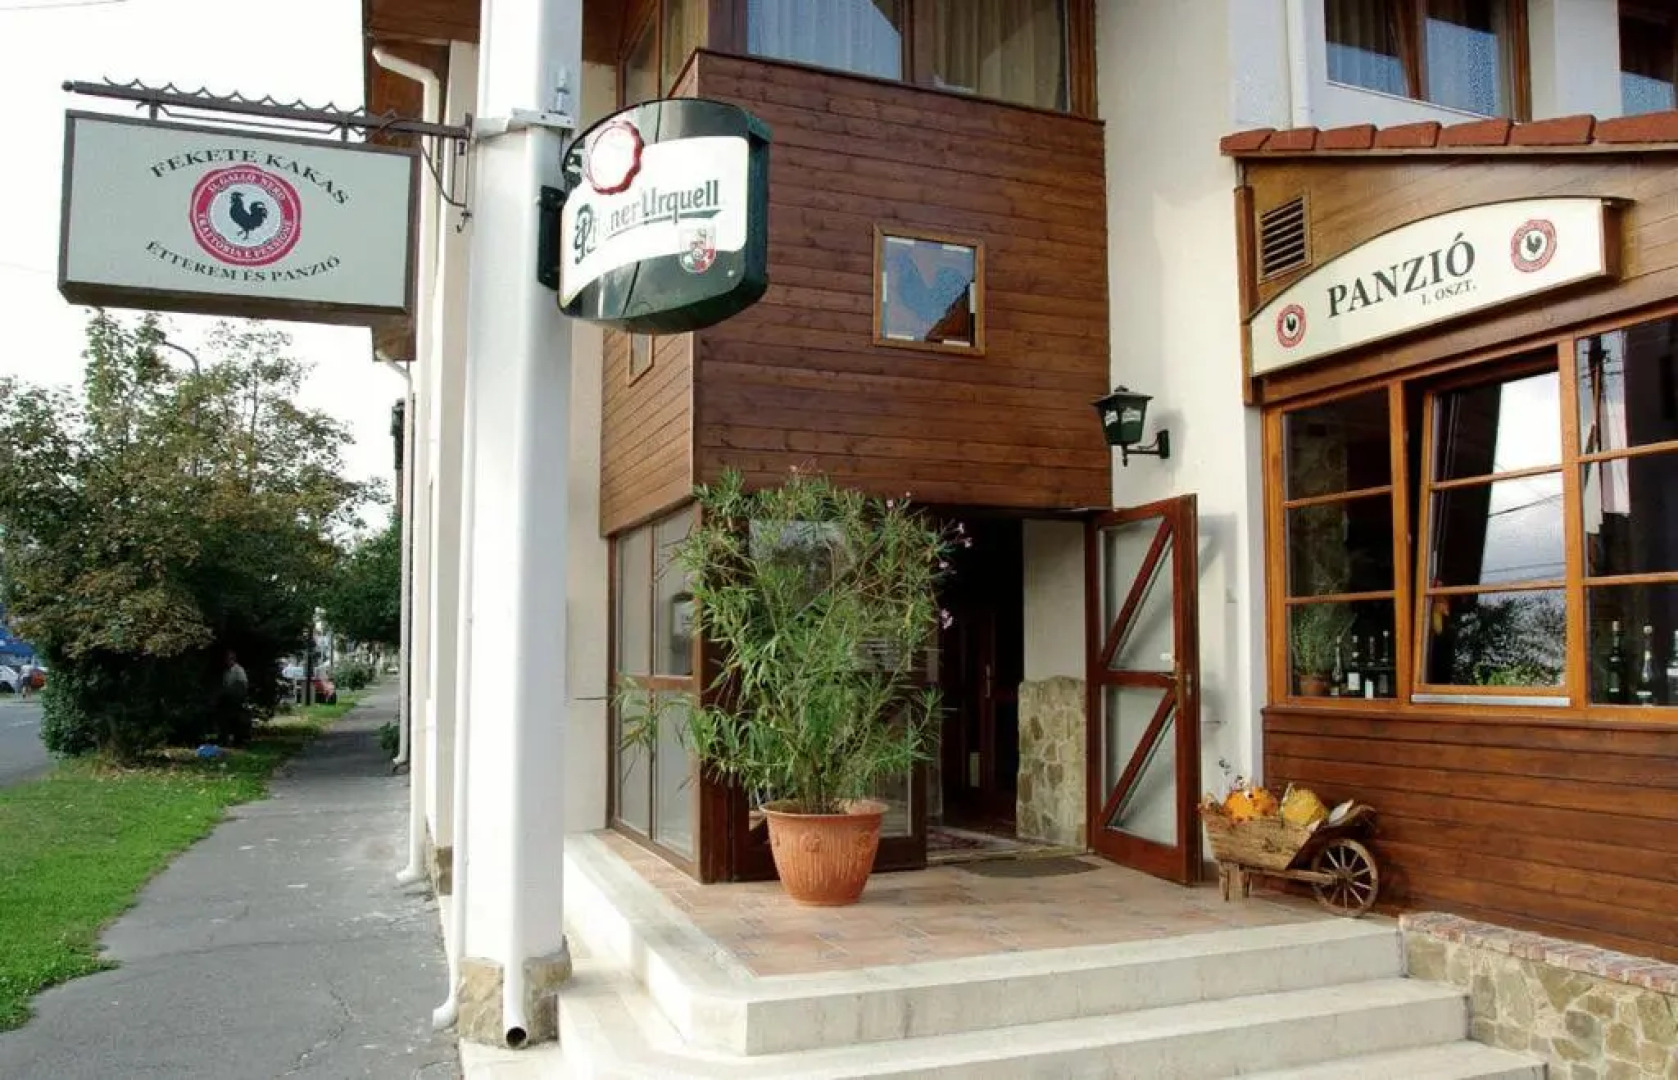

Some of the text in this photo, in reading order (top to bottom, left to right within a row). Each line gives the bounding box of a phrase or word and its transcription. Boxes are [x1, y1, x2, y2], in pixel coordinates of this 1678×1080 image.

[150, 148, 349, 204] FEKETE KAKAS
[641, 179, 720, 226] Urquell
[1326, 231, 1477, 318] PANZIÓ
